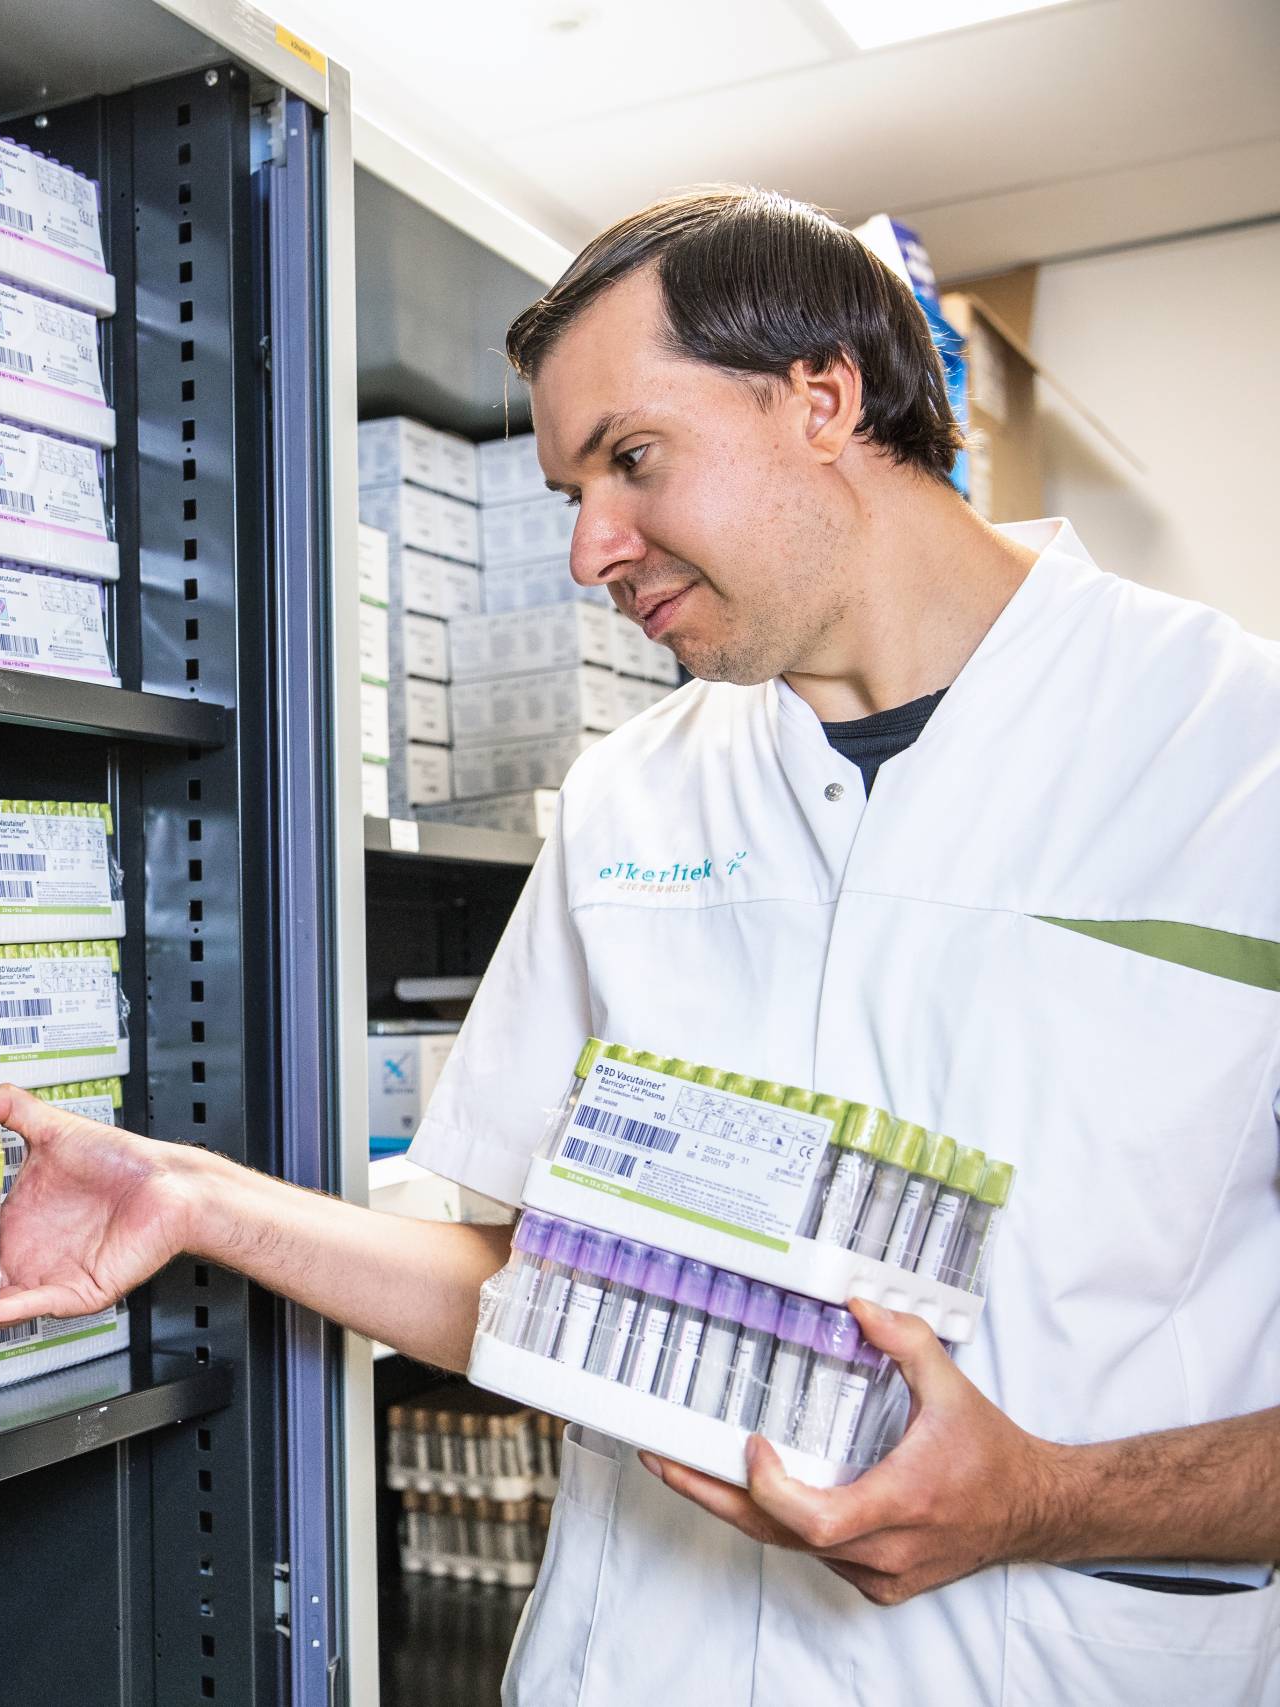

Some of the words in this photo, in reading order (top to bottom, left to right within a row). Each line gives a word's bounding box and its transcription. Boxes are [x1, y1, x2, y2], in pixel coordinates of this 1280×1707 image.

[599, 858, 712, 882] elkerliek
[604, 1067, 615, 1078] BD
[630, 1085, 640, 1093] LH
[641, 1088, 665, 1101] Plasma
[653, 1112, 665, 1121] 100
[701, 1155, 730, 1169] 2010179
[704, 1145, 720, 1155] 2023
[742, 1156, 749, 1164] 31
